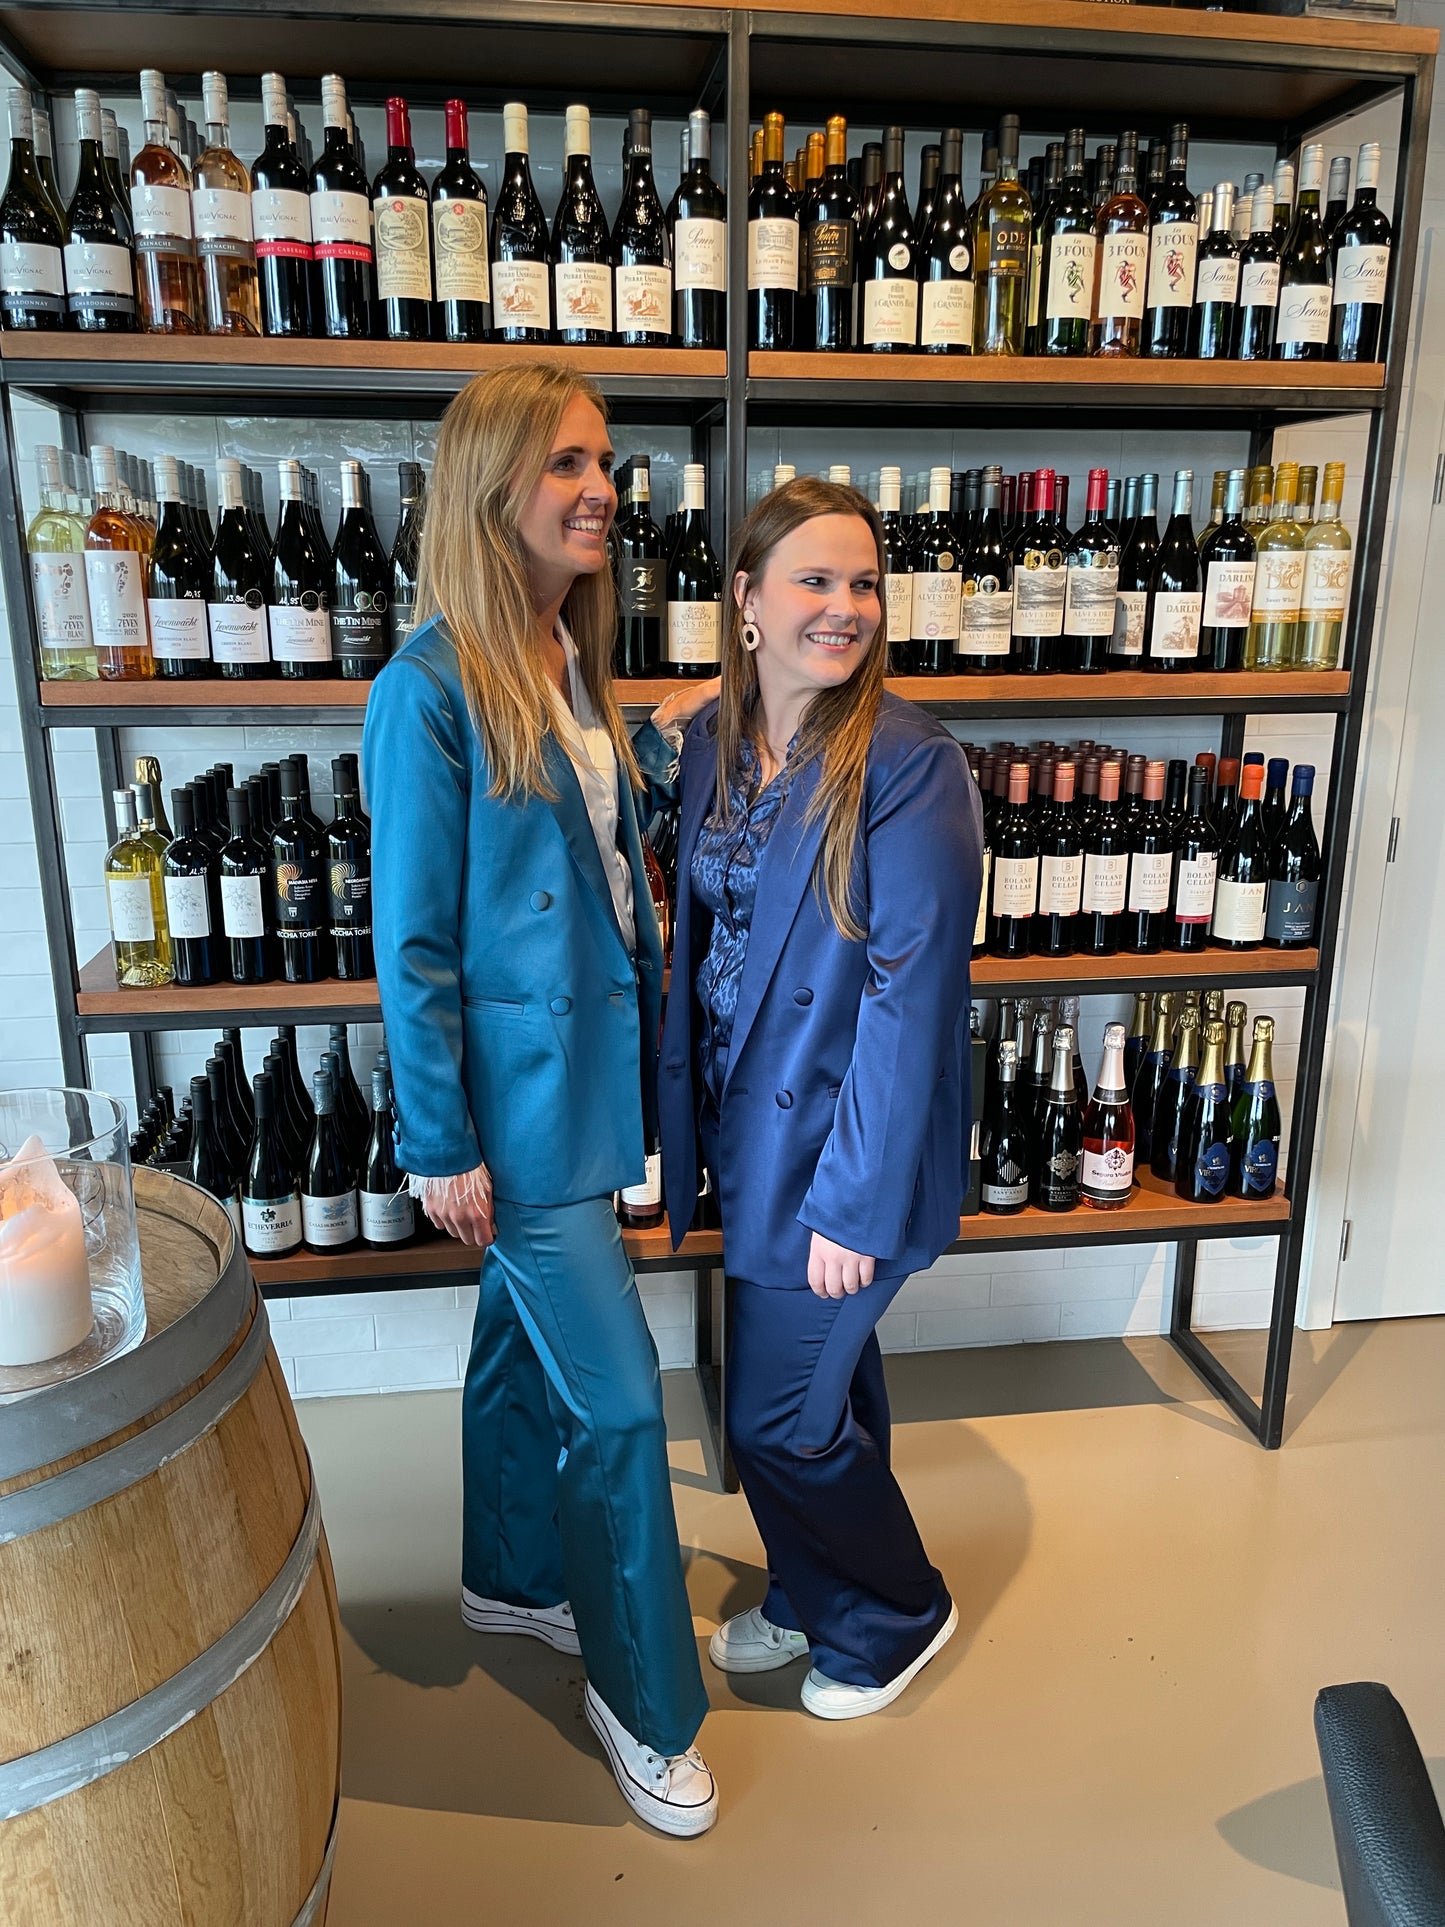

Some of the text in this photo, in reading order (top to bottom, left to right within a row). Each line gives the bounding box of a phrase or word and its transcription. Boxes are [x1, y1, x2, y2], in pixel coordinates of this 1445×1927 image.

[1155, 235, 1195, 248] 3 FOUS
[1054, 246, 1094, 258] 3 FOUS
[1108, 246, 1146, 258] 3 FOUS
[300, 930, 318, 938] TORRE
[354, 928, 371, 936] TORRE
[248, 1220, 293, 1231] ECHEVERRIA
